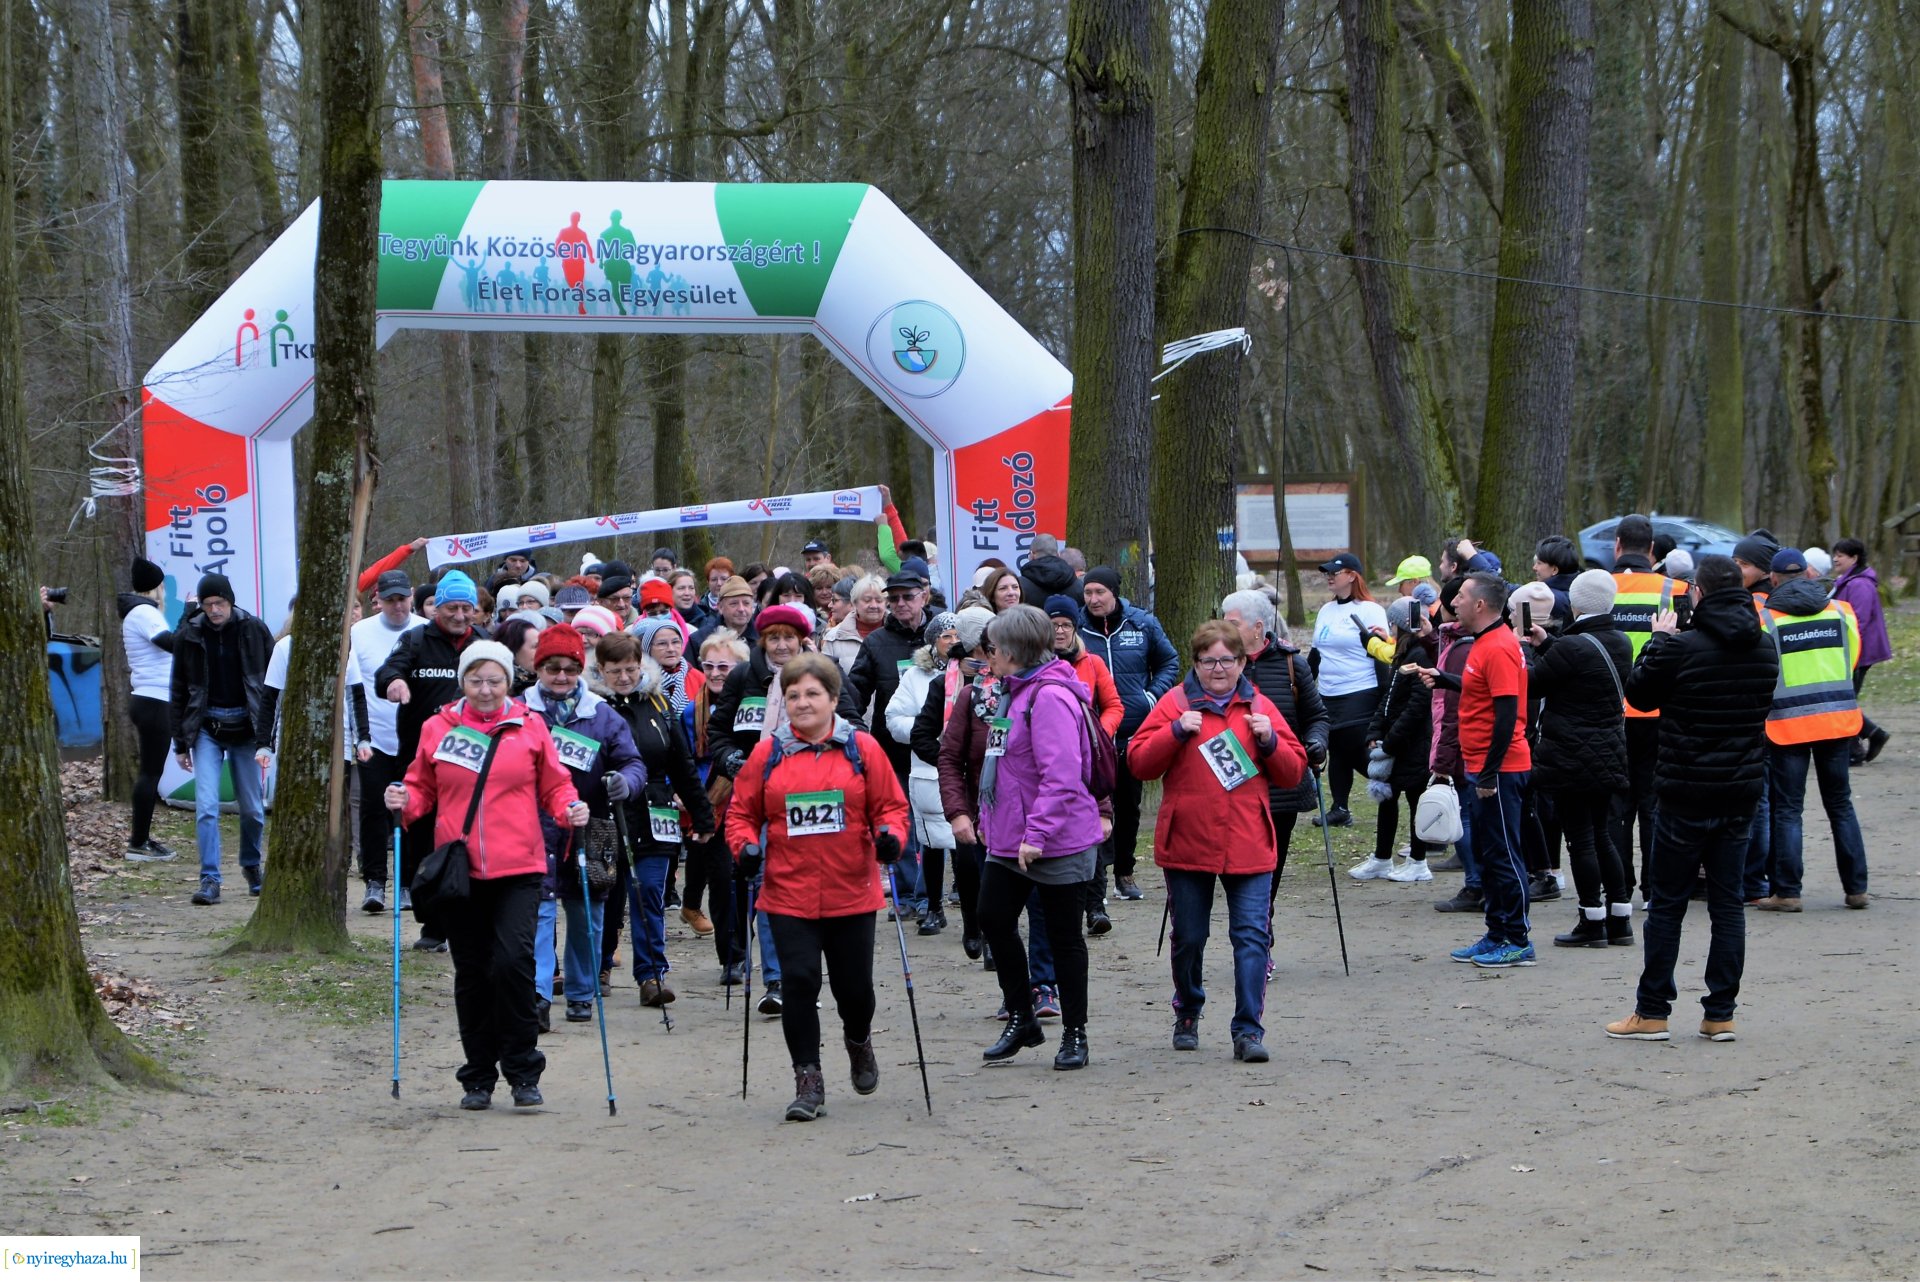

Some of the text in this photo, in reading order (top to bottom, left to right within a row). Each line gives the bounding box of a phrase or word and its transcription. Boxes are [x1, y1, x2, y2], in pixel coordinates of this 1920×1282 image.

[379, 234, 820, 267] Tegyünk Közösen Magyarországért !
[478, 276, 738, 306] Élet Forása Egyesület
[170, 505, 194, 557] Fitt
[194, 484, 235, 575] Ápoló
[972, 499, 999, 550] Fitt
[1782, 628, 1838, 642] POLGÁRŐRSÉG
[419, 668, 456, 679] SQUAD
[737, 706, 766, 724] 065
[442, 735, 484, 761] 029
[1209, 738, 1243, 778] 023
[653, 818, 677, 835] 013
[790, 804, 834, 826] 042
